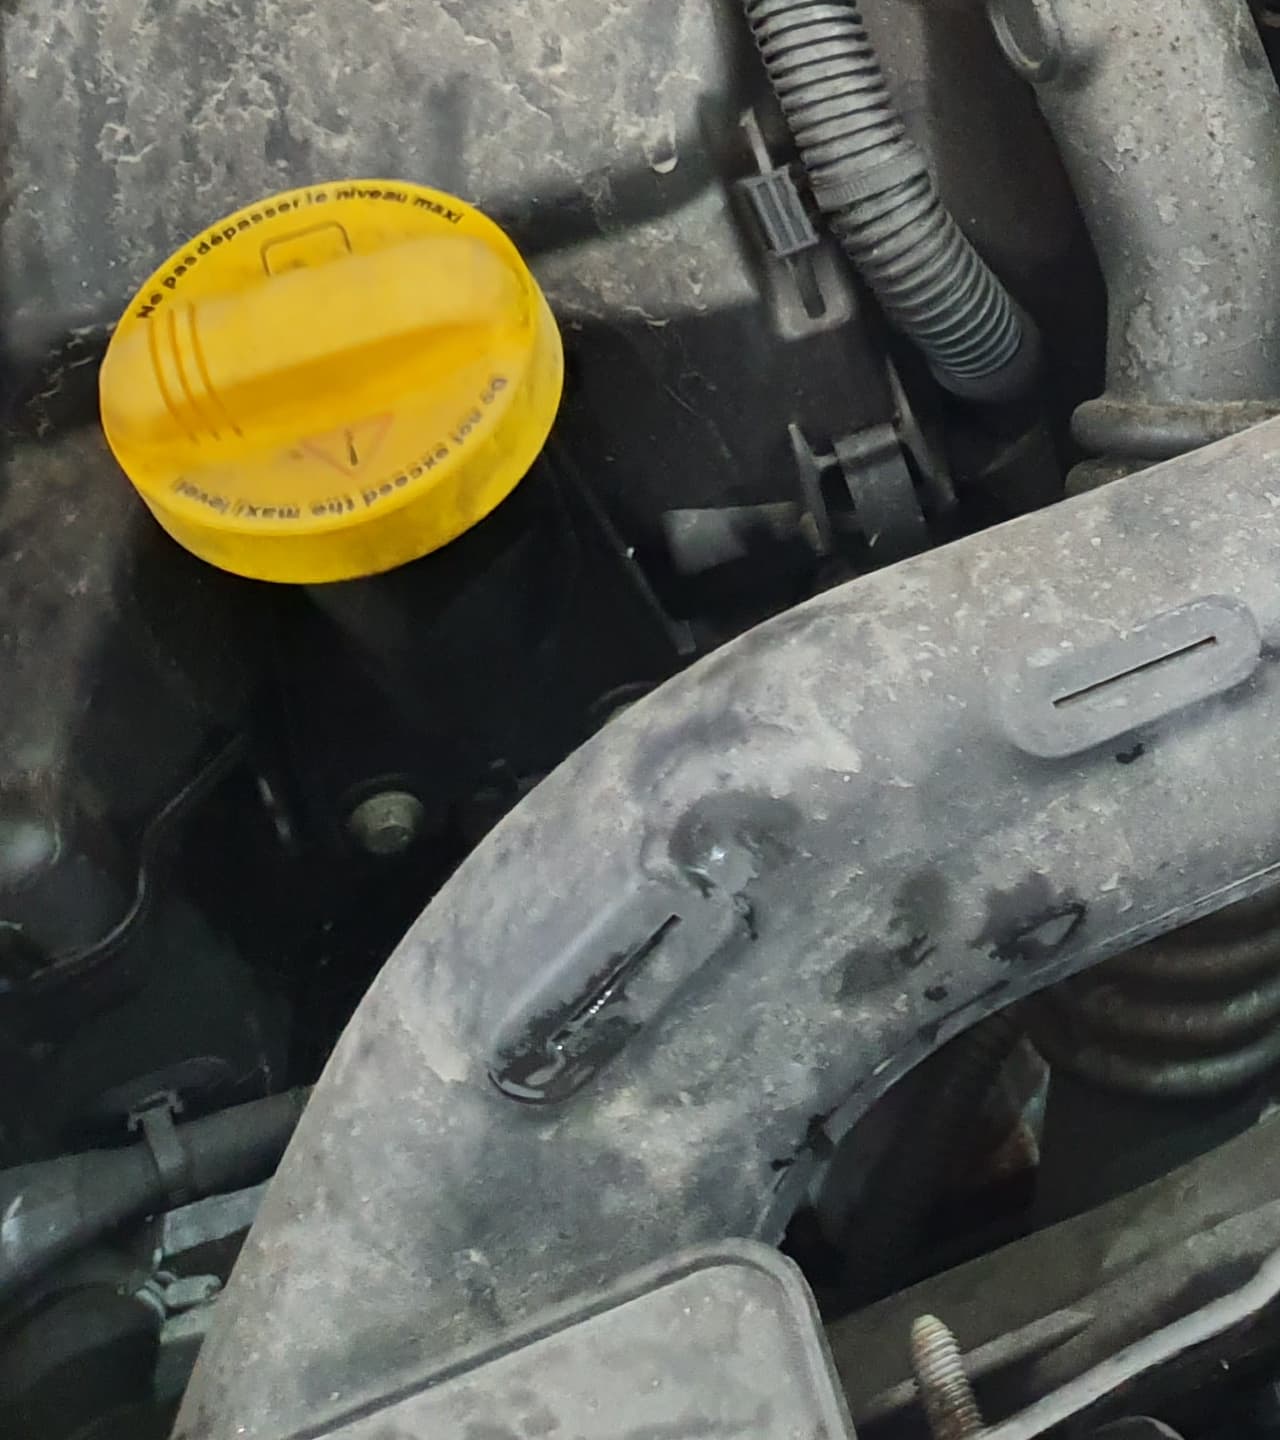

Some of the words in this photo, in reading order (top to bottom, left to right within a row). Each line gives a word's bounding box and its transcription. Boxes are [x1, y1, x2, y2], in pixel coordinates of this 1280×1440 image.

[136, 291, 163, 319] Ne
[162, 255, 197, 290] pas
[306, 189, 329, 205] le
[335, 187, 408, 204] niveau
[412, 193, 465, 224] maxi
[480, 376, 509, 405] Do
[450, 407, 483, 446] not
[362, 445, 450, 507] exceed
[234, 504, 301, 519] maxi
[311, 497, 355, 517] the
